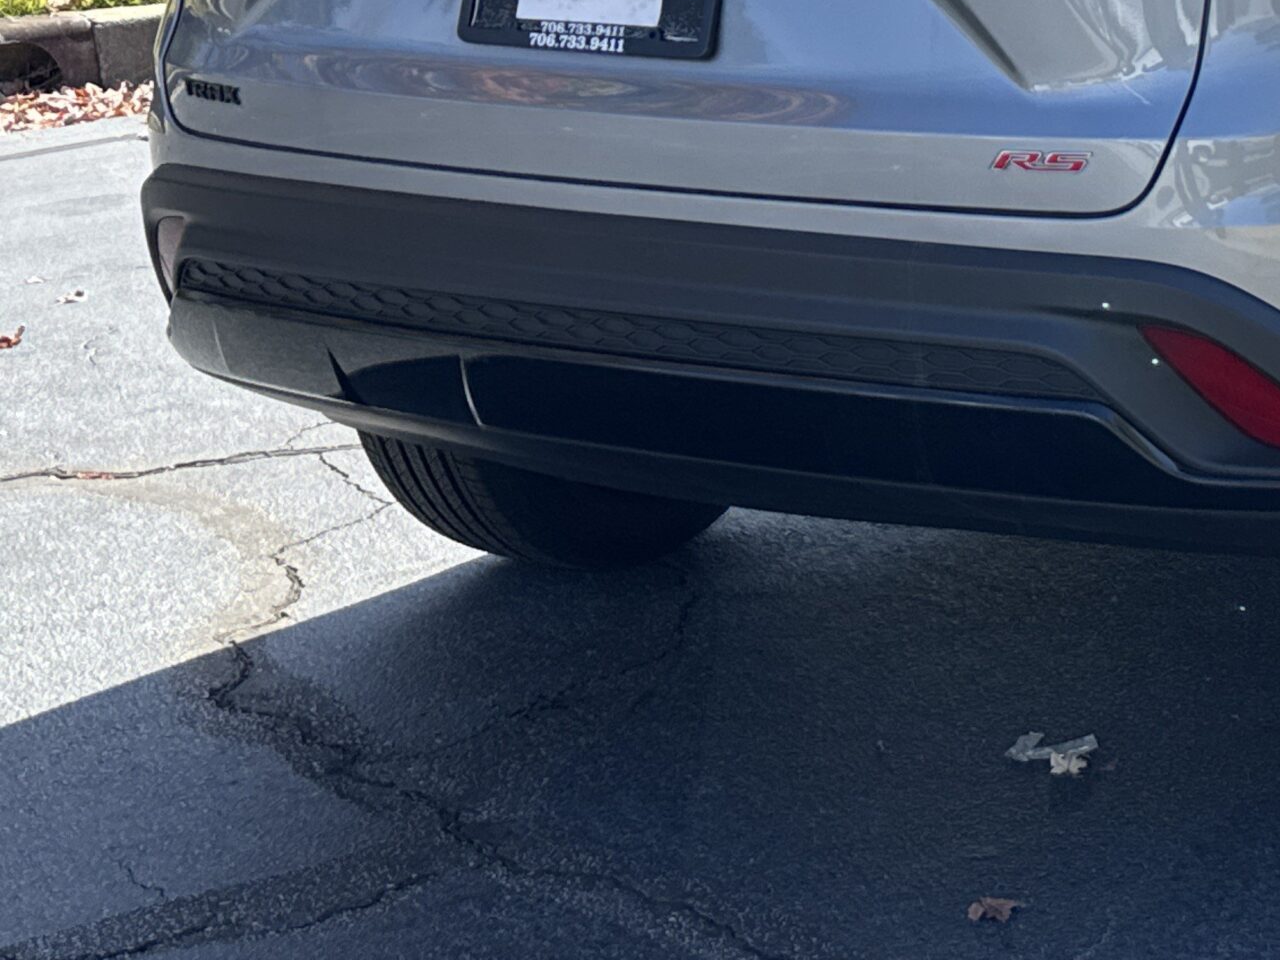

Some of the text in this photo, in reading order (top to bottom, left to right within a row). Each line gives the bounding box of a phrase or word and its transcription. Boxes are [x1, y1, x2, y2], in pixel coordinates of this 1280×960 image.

[540, 21, 625, 37] 706.733.9411
[529, 32, 625, 53] 706.733.9411
[989, 149, 1093, 172] RS
